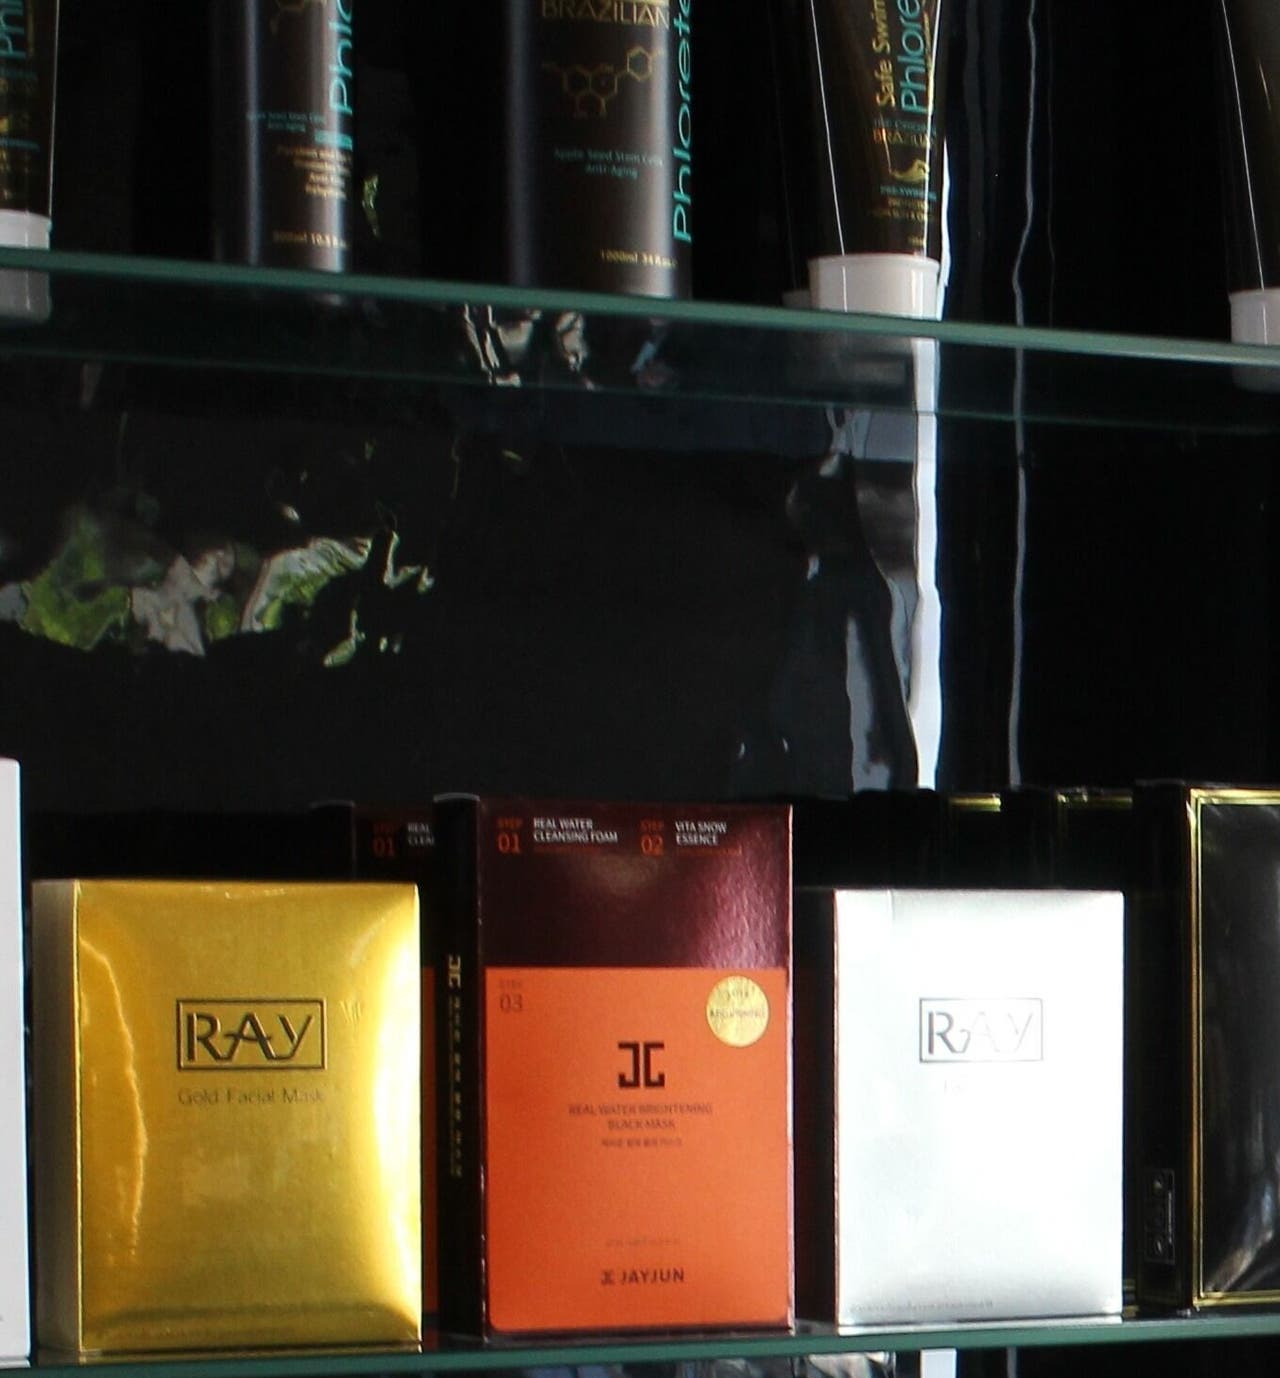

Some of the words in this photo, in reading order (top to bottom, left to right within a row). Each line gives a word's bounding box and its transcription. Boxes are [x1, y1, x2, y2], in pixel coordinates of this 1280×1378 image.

[542, 0, 669, 29] BRAZILIAN
[533, 817, 558, 831] REAL
[559, 817, 594, 832] WATER
[675, 821, 697, 834] VITA
[698, 822, 726, 836] SNOW
[498, 832, 521, 853] 01
[533, 829, 587, 844] CLEANSING
[588, 831, 618, 844] FOAM
[641, 833, 664, 856] 02
[675, 834, 719, 847] ESSENCE
[187, 1011, 313, 1062] RAY
[620, 1266, 685, 1285] JAYJUN
